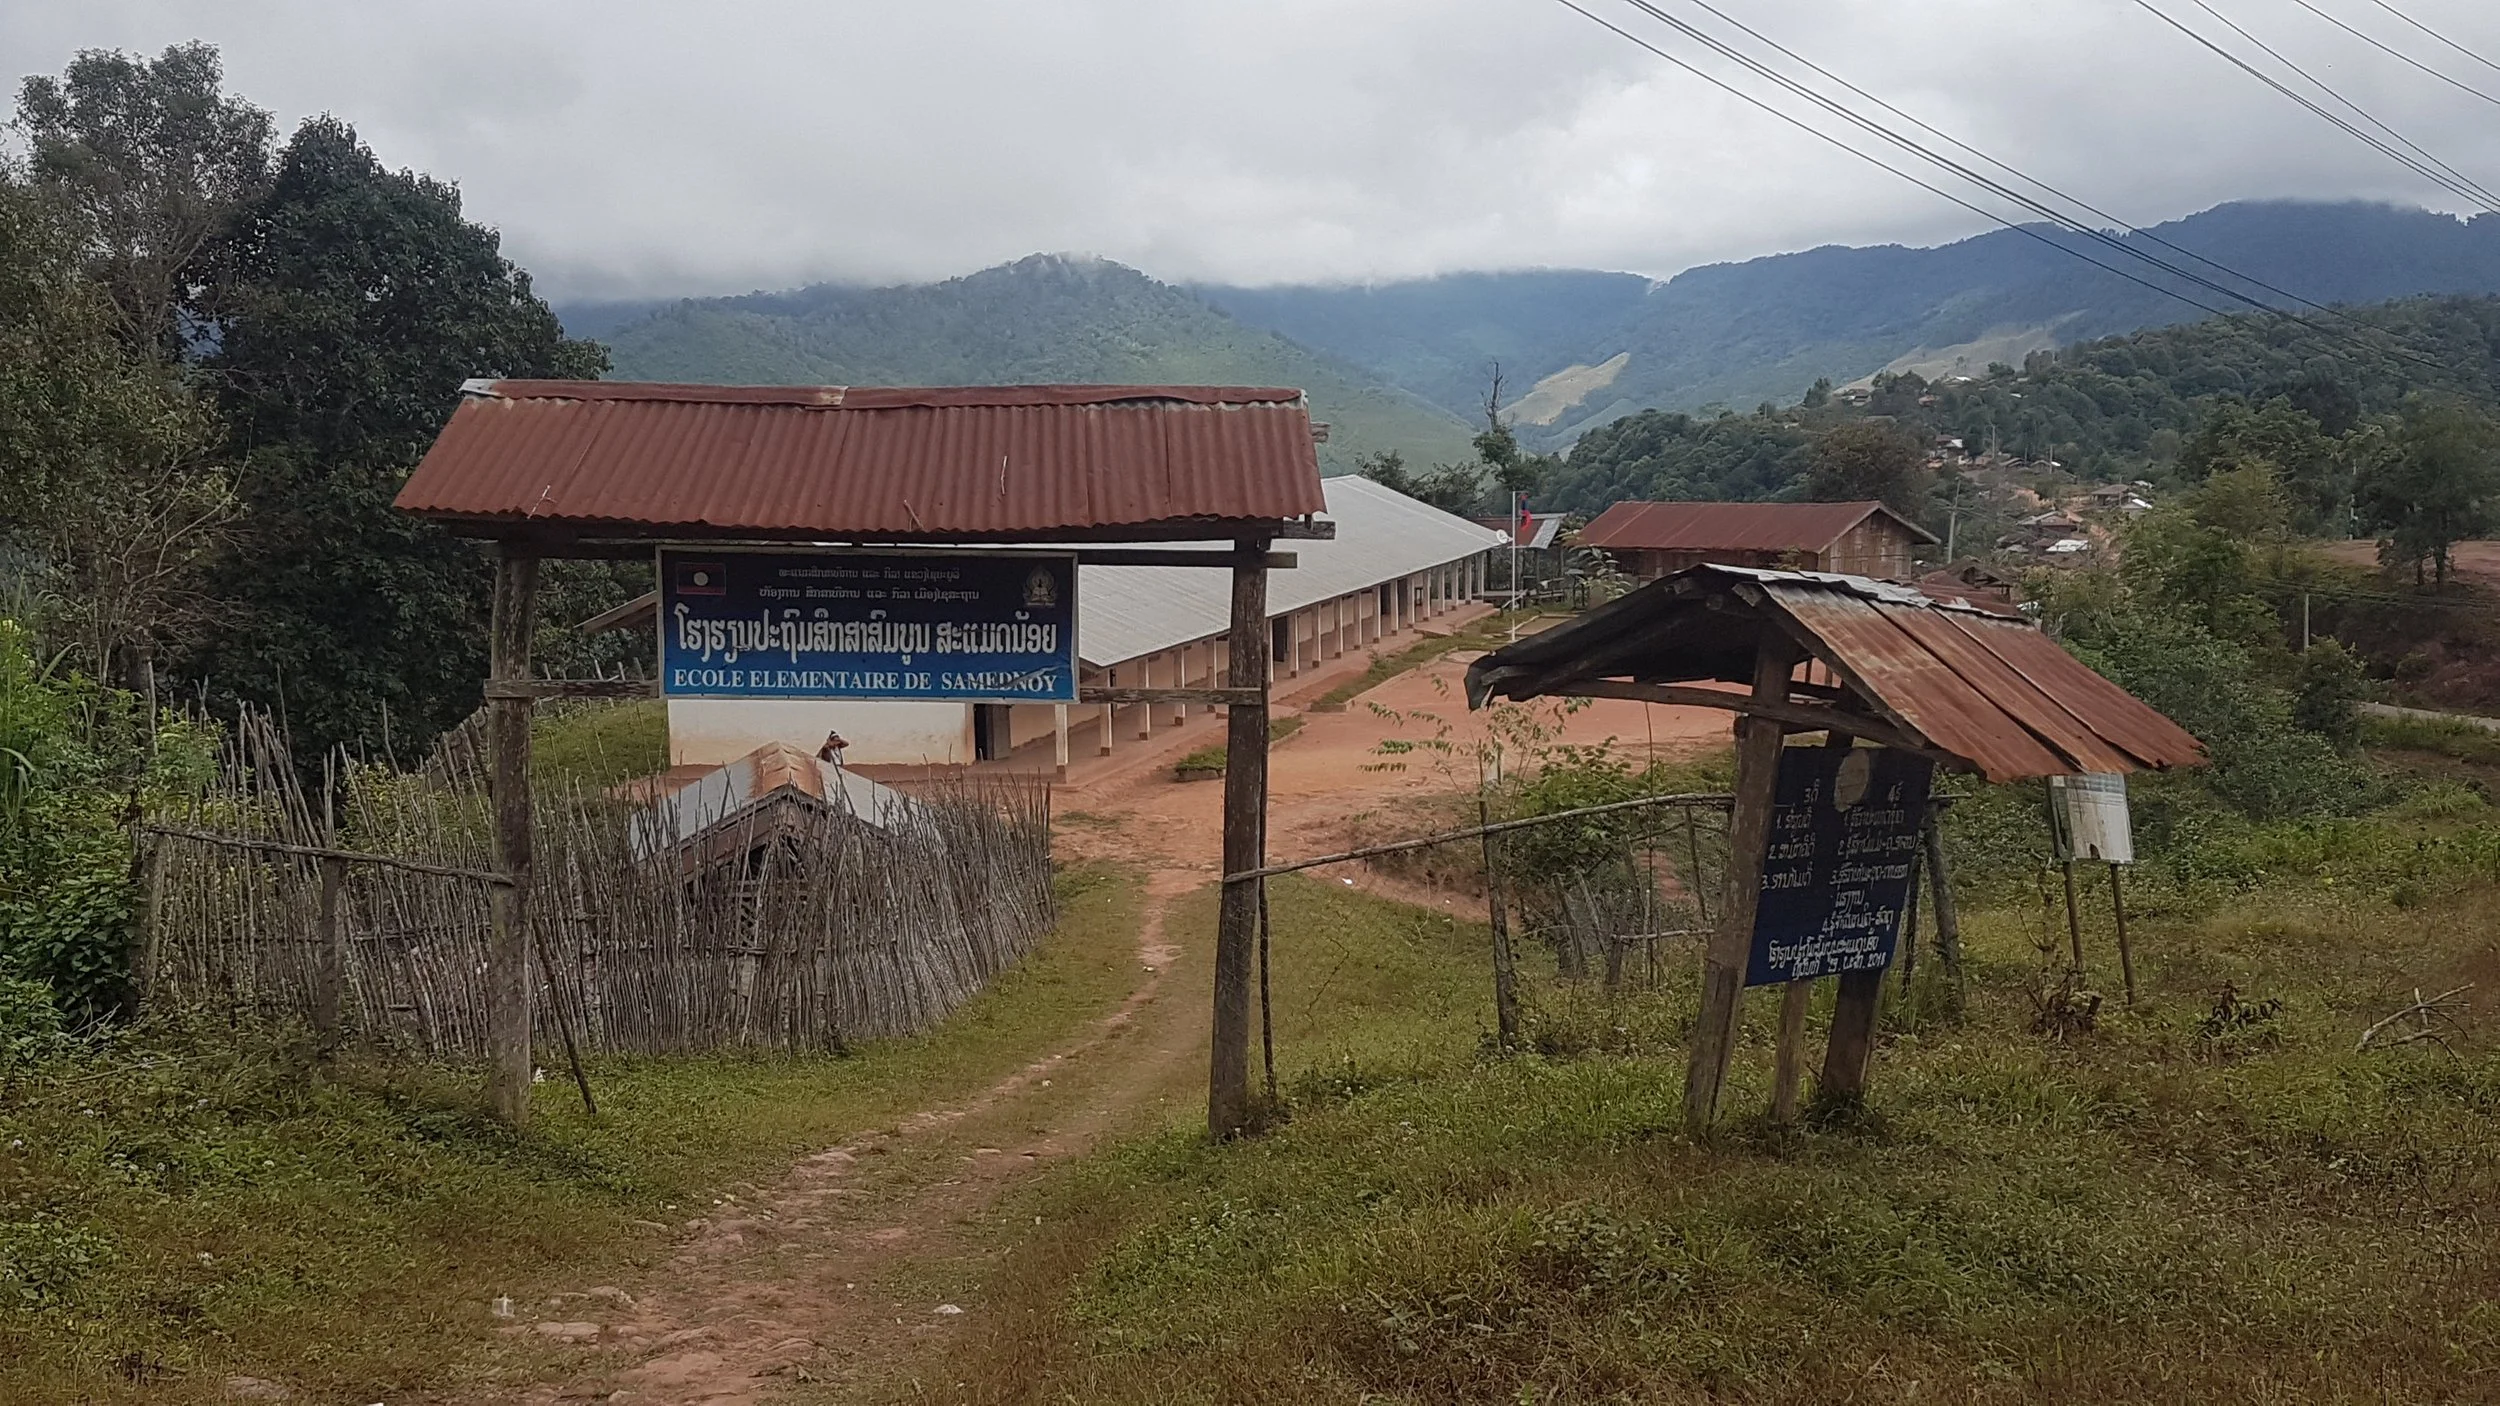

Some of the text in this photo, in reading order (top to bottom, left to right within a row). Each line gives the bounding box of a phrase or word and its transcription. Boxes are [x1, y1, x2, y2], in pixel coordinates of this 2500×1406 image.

[673, 669, 745, 688] ECOLE
[749, 670, 900, 690] ELEMENTAIRE
[903, 672, 932, 690] DE
